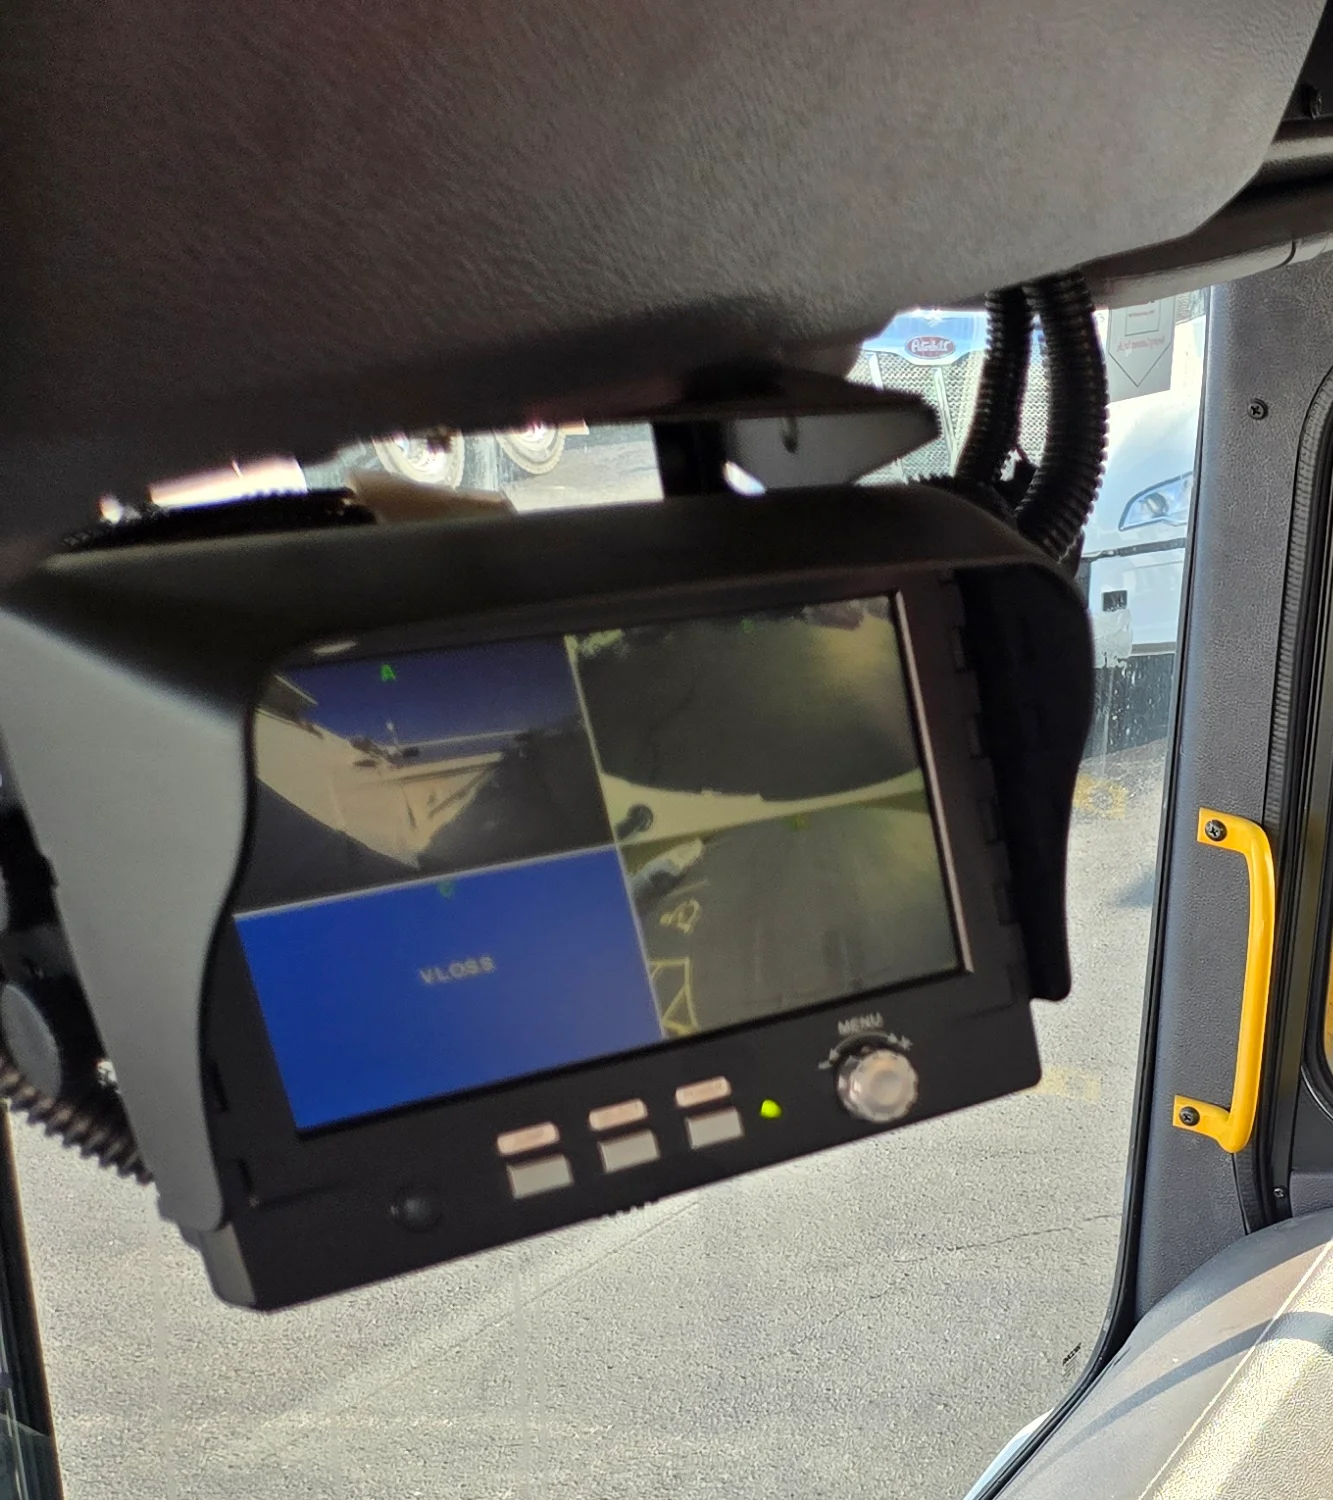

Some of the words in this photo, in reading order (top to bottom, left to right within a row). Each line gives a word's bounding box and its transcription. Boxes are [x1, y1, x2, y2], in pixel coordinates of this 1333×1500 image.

[380, 664, 396, 682] A
[419, 955, 495, 985] VLOSS
[837, 1011, 884, 1036] MENU
